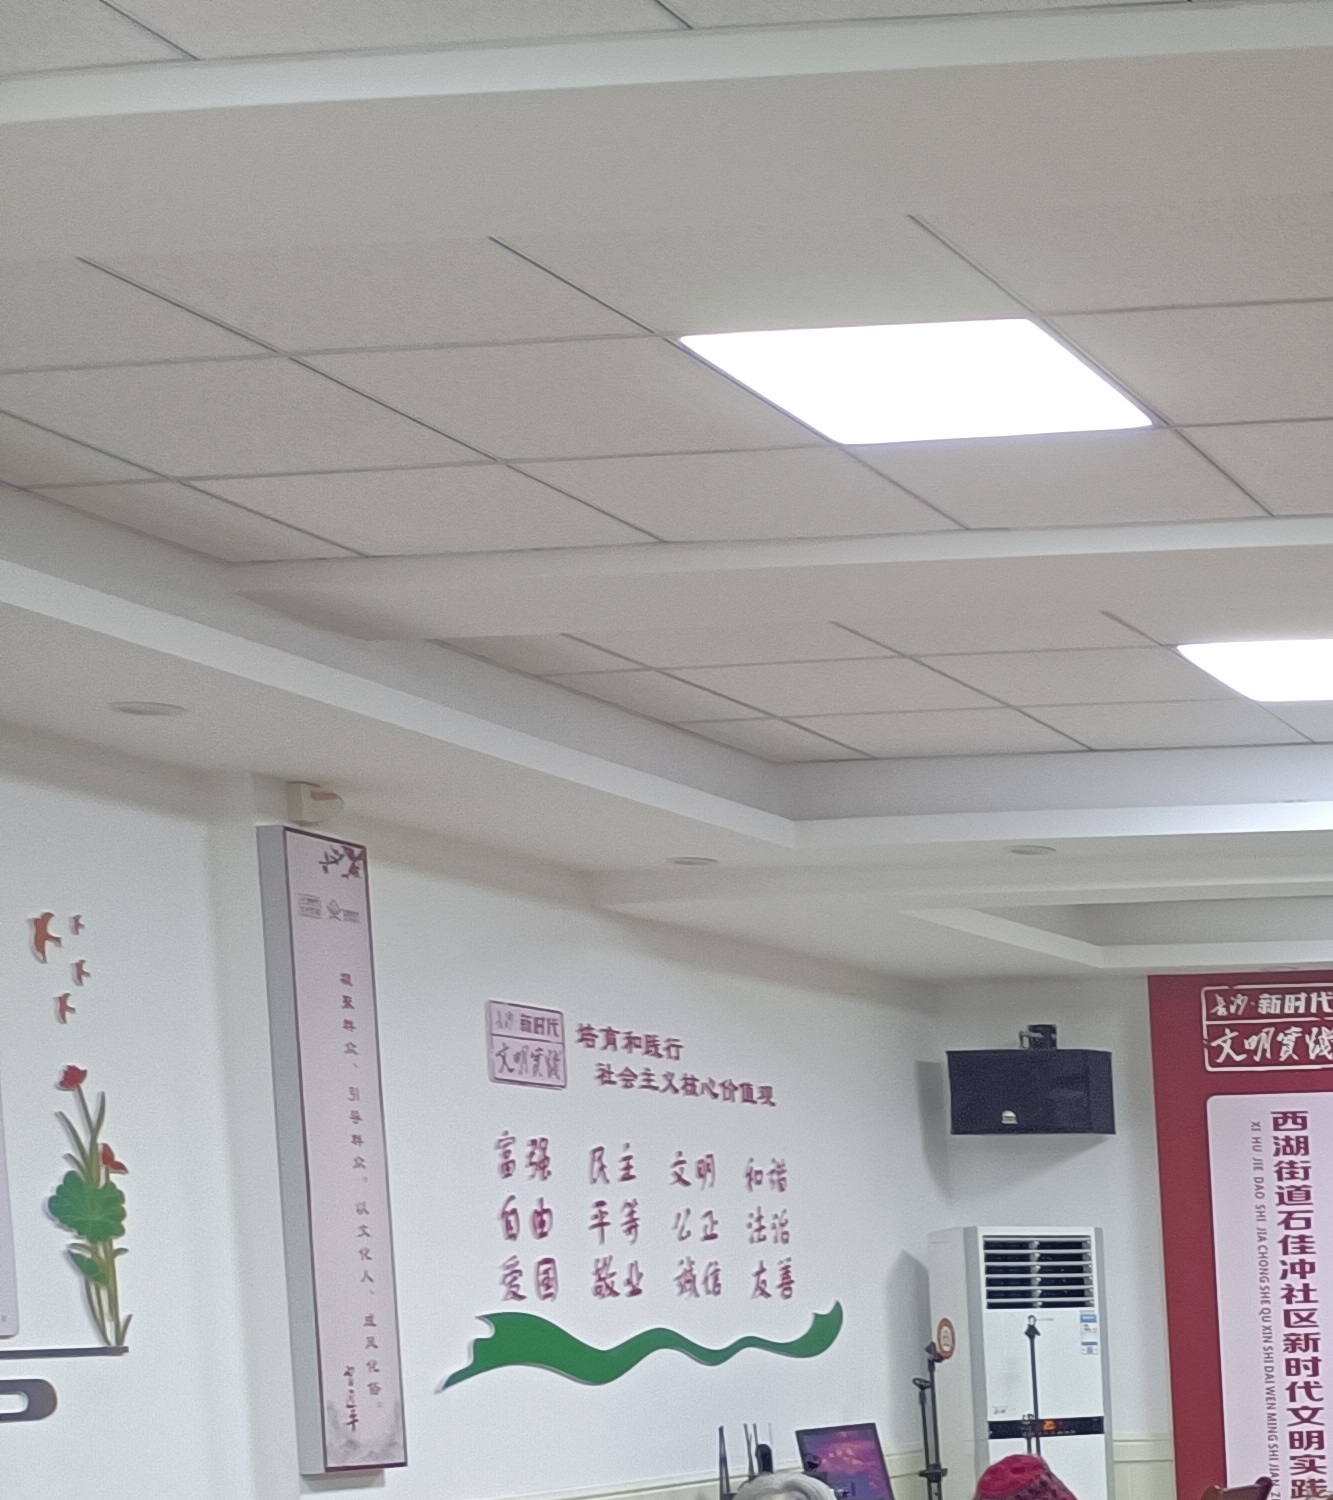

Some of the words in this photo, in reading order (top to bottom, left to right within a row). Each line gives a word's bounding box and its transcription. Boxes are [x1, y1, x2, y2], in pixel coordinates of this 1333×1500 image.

[576, 1023, 685, 1060] 培育和践行
[594, 1063, 776, 1107] 社会主义核心价值观
[1250, 1121, 1261, 1131] XI
[1251, 1136, 1263, 1152] HU
[495, 1130, 552, 1181] 富强
[590, 1143, 636, 1185] 民主
[670, 1150, 716, 1190] 文明
[744, 1157, 787, 1192] 和谐
[1252, 1157, 1264, 1171] JIE
[1253, 1177, 1265, 1199] DAO
[500, 1195, 553, 1240] 自由
[588, 1198, 640, 1245] 平等
[672, 1208, 718, 1241] 公正
[746, 1206, 790, 1244] 法治
[1255, 1204, 1267, 1222] SHI
[1256, 1227, 1268, 1242] JIA
[1257, 1245, 1270, 1283] CHONG
[499, 1255, 559, 1301] 爱国
[592, 1254, 644, 1299] 敬业
[674, 1256, 722, 1299] 诚信
[750, 1257, 795, 1299] 友善
[1259, 1285, 1271, 1305] SHE
[1259, 1307, 1272, 1323] QU
[1262, 1325, 1273, 1343] XIN
[1262, 1346, 1274, 1363] SHI
[1264, 1365, 1275, 1384] DAI
[1265, 1386, 1276, 1410] WEN
[1266, 1413, 1278, 1441] MING
[1268, 1443, 1279, 1461] SHI
